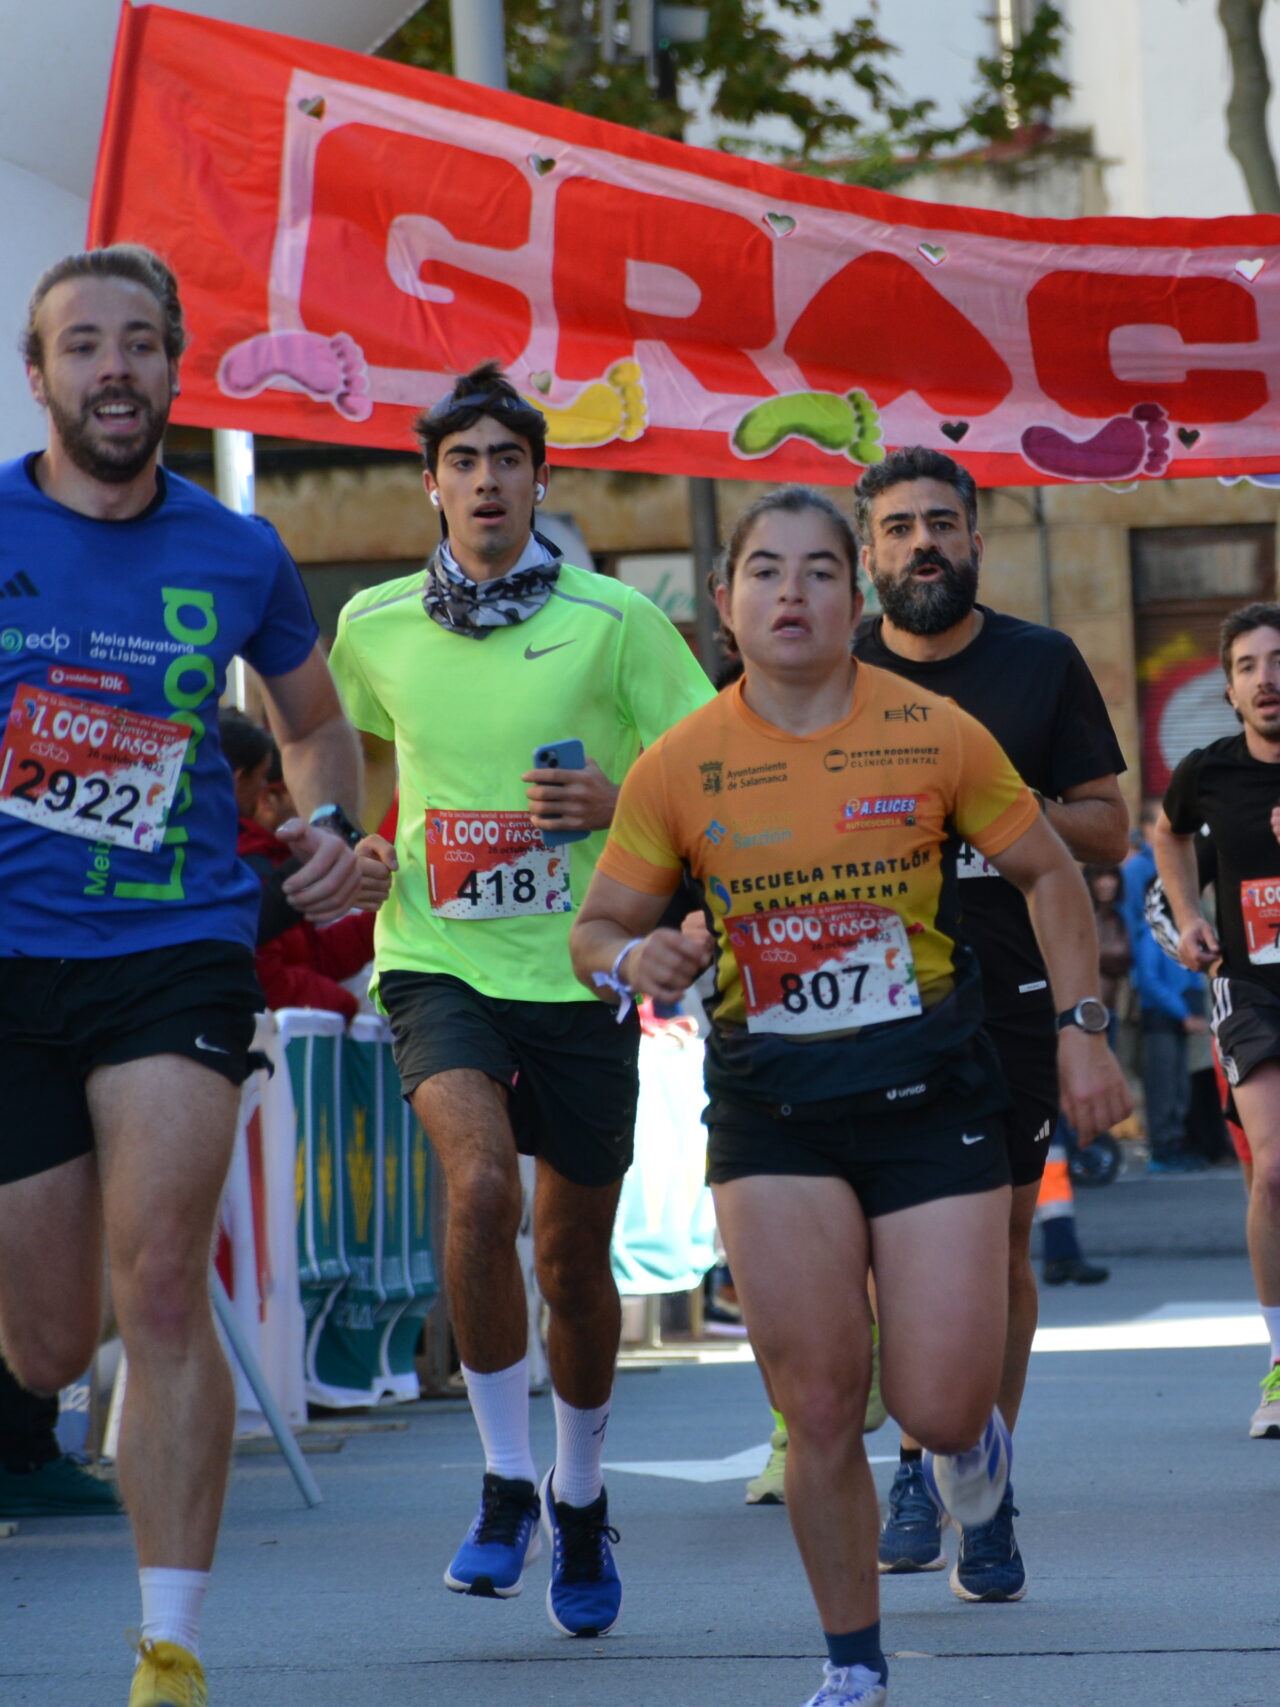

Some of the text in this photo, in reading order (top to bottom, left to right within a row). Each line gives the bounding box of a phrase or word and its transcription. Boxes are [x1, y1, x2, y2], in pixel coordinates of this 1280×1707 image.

[26, 627, 70, 655] edp
[91, 631, 195, 654] Meia Maratona
[90, 646, 156, 666] de Lisboa
[100, 675, 124, 691] 10k
[884, 703, 932, 722] EKT
[32, 705, 108, 748] 1.000
[850, 750, 880, 759] ESTER
[898, 756, 938, 765] DENTAL
[728, 762, 788, 779] Ayuntamiento
[728, 774, 788, 791] de Salamanca
[11, 759, 141, 829] 2922
[874, 798, 916, 813] ELICES
[441, 819, 544, 847] 1.000 PASO
[730, 850, 931, 895] ESCUELA TRIATLÓN
[457, 868, 536, 906] 418
[753, 881, 909, 913] SALMANTINA
[750, 916, 822, 945] 1.000
[780, 964, 870, 1014] 807
